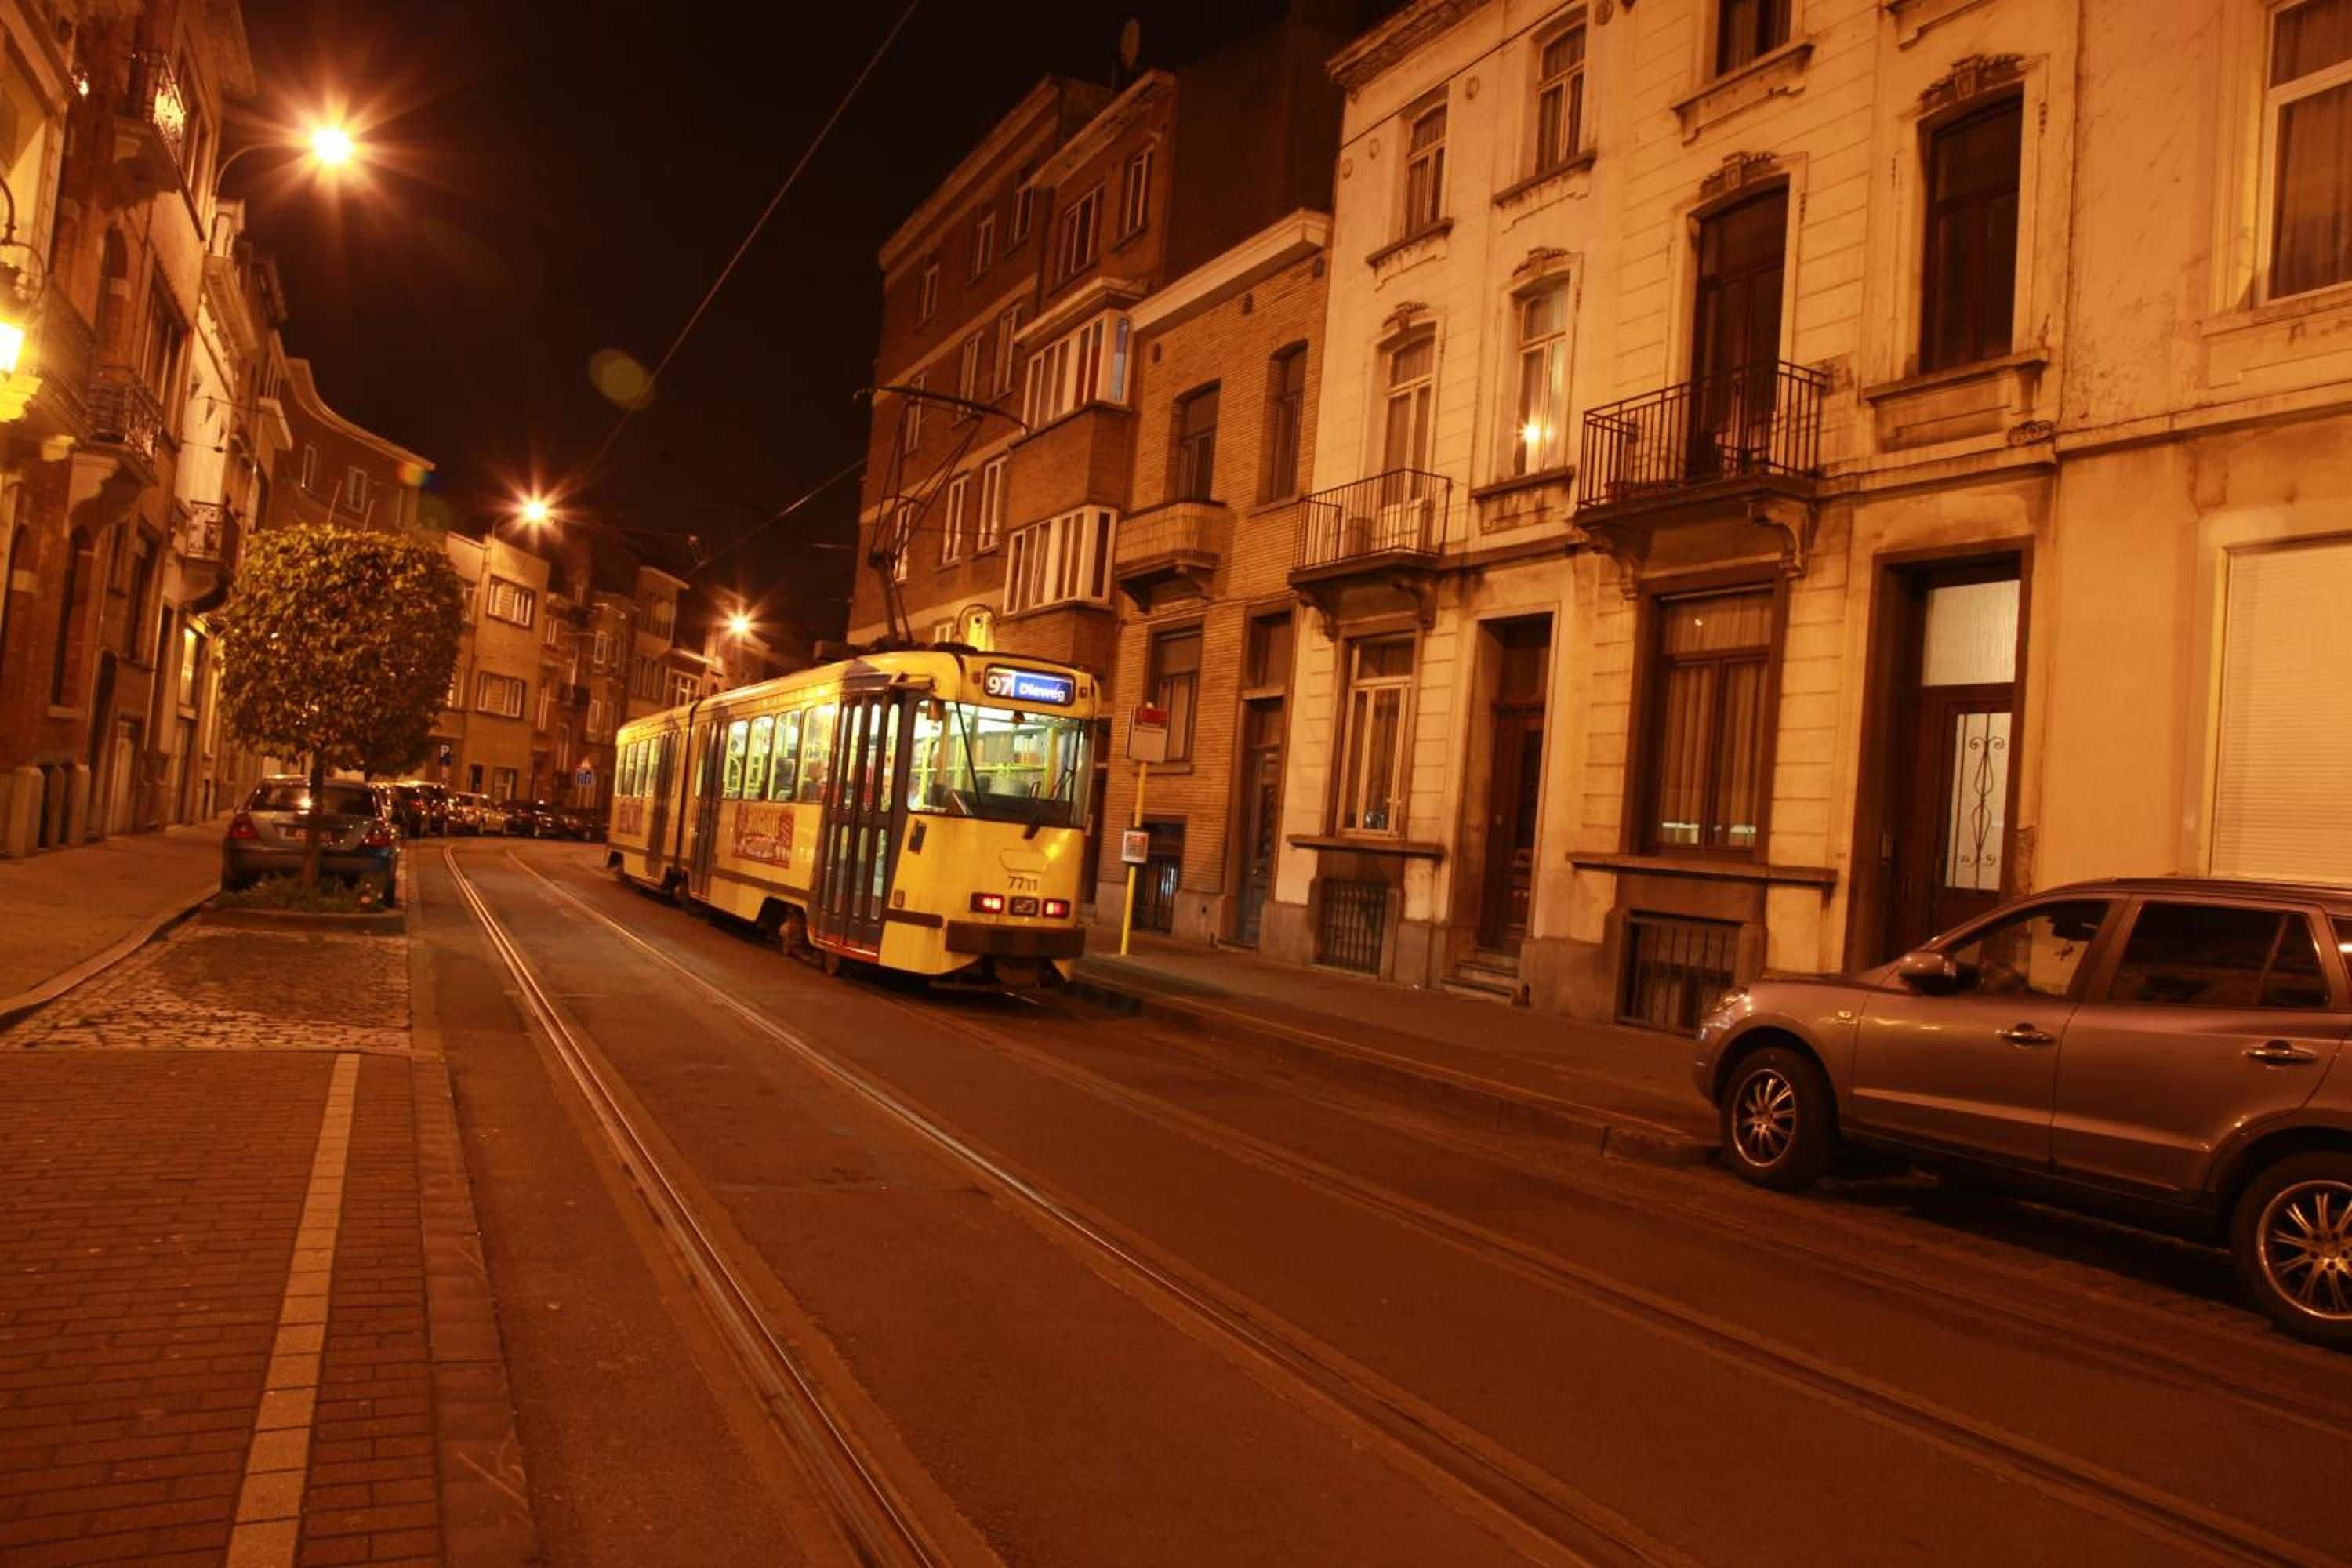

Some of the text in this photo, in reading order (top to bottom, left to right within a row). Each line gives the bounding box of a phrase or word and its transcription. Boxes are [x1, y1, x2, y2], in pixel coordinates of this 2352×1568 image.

[987, 675, 1011, 696] 97
[440, 744, 450, 758] P
[1007, 875, 1038, 891] 7711
